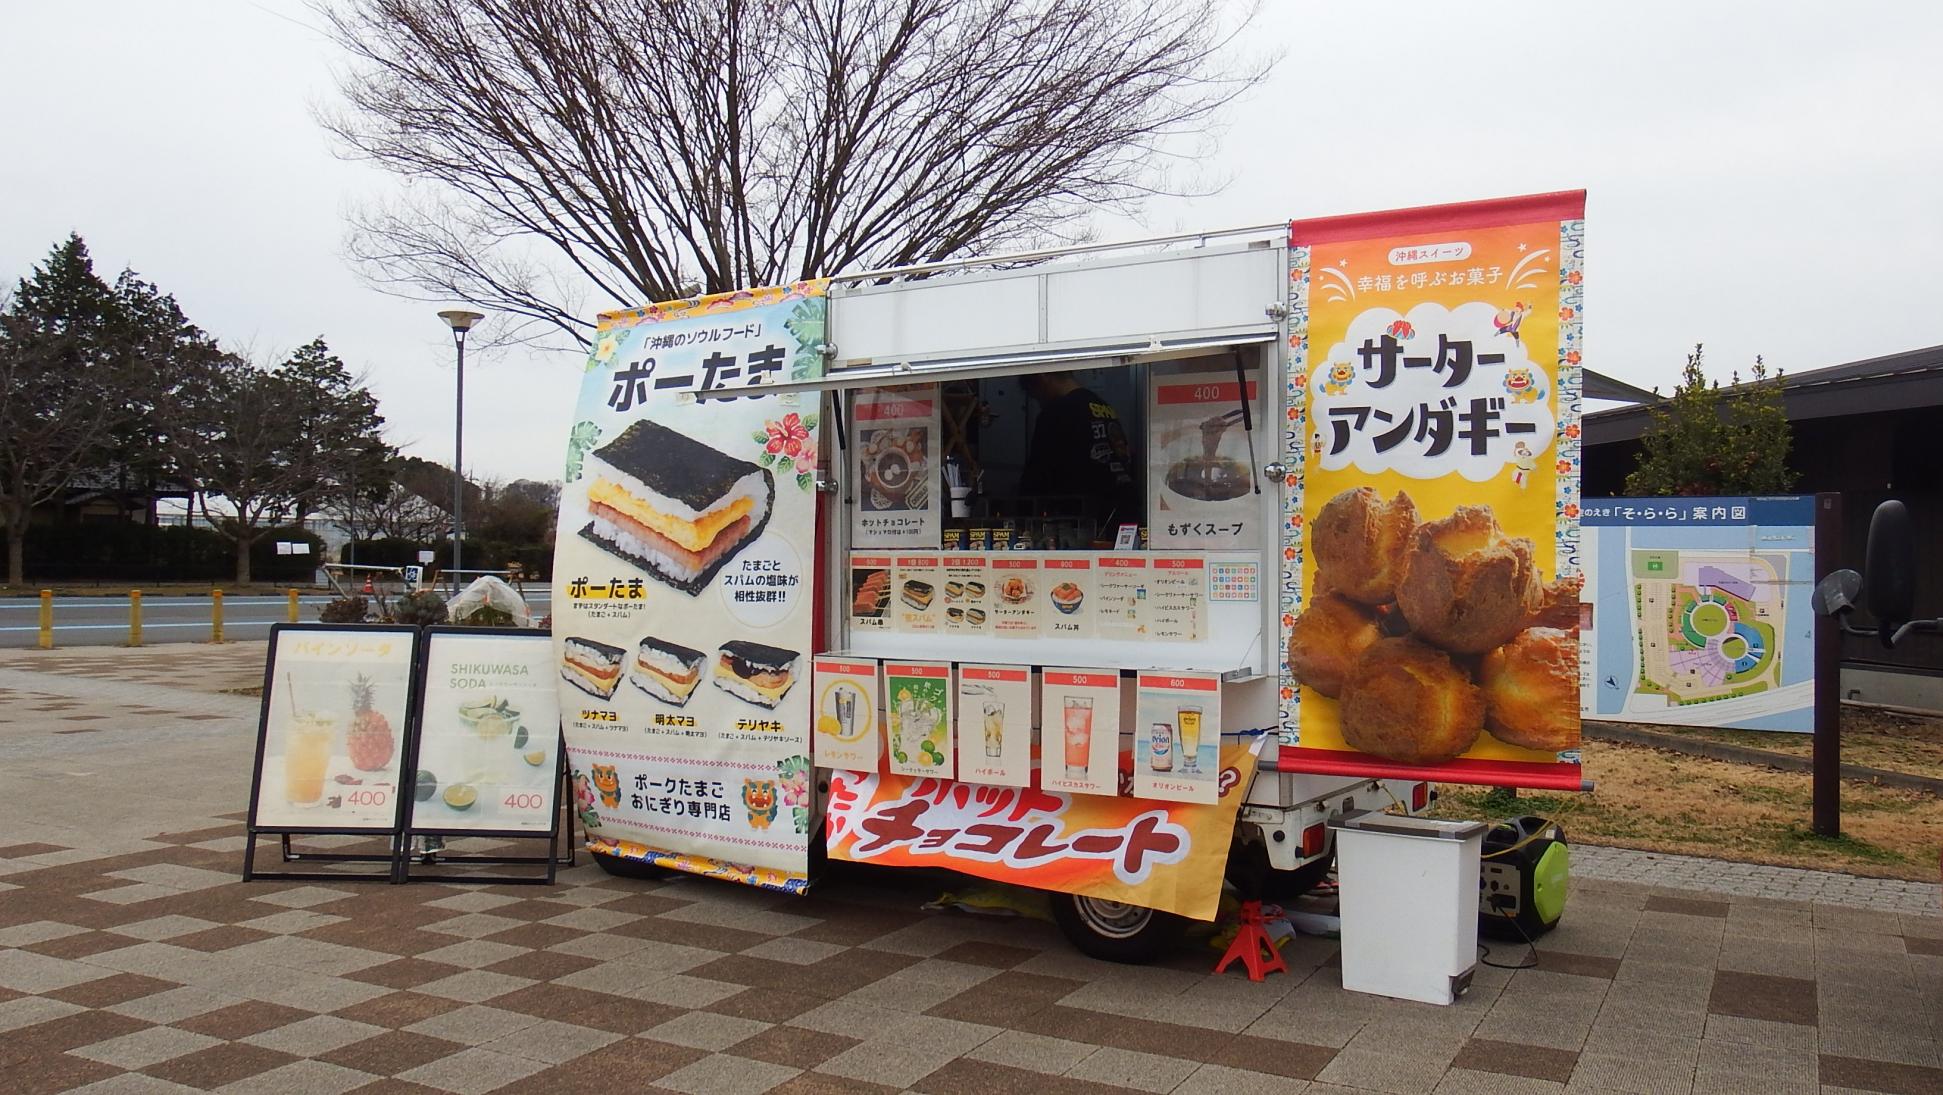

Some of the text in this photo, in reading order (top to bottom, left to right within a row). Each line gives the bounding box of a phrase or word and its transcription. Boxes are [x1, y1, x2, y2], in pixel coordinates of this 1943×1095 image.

[1394, 246, 1464, 263] 沖縄スイーツ
[1357, 266, 1503, 293] 幸福を呼ぶお菓子
[643, 323, 762, 351] 「沖縄のソウルフード」
[1356, 333, 1505, 388] サーター
[607, 344, 786, 412] ポーたま
[1194, 385, 1219, 400] 400
[1328, 396, 1536, 457] アンダギー
[861, 518, 925, 528] ホットチョコレート
[1168, 522, 1244, 536] もずくスープ
[944, 532, 960, 540] SPAM
[970, 531, 986, 539] SPAM
[993, 531, 1010, 539] SPAM
[742, 560, 781, 571] たまごと
[1115, 559, 1129, 567] 400
[570, 576, 644, 599] ポーたま
[724, 575, 799, 587] スパムの塩味が
[450, 663, 529, 676] SHIKUWASA
[987, 670, 1000, 679] 500
[449, 678, 487, 689] SODA
[1073, 675, 1088, 684] 500
[1170, 679, 1185, 687] 600
[582, 710, 617, 721] ツナマヨ
[655, 713, 695, 727] 明太マヨ
[737, 719, 782, 732] テリヤキ
[975, 769, 1006, 777] ハイボール
[634, 773, 724, 799] ポークたまご
[1051, 780, 1101, 790] ハイビスカスサワー
[1152, 781, 1195, 792] オリオンビール
[347, 791, 386, 806] 400
[504, 793, 543, 808] 400
[630, 793, 731, 822] おにぎり専門店
[858, 799, 1180, 873] チョコレート
